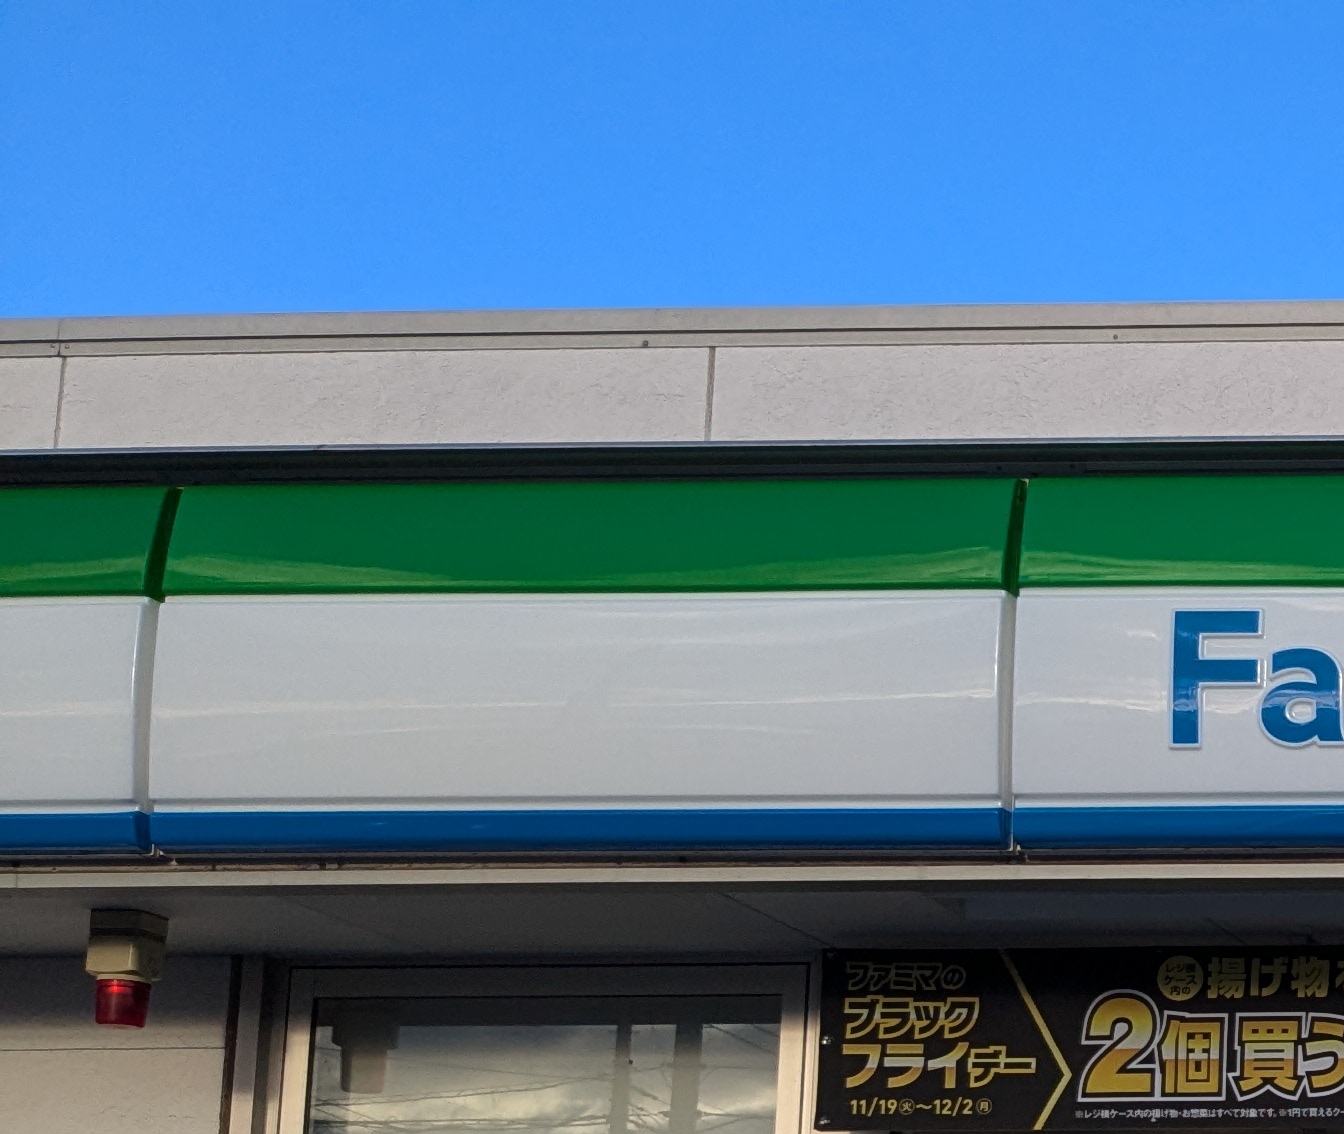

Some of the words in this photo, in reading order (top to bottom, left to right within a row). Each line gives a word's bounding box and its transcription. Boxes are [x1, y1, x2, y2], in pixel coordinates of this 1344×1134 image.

[846, 961, 966, 991] ファミマの
[844, 995, 979, 1039] ブラック
[842, 1042, 1036, 1088] フライデー
